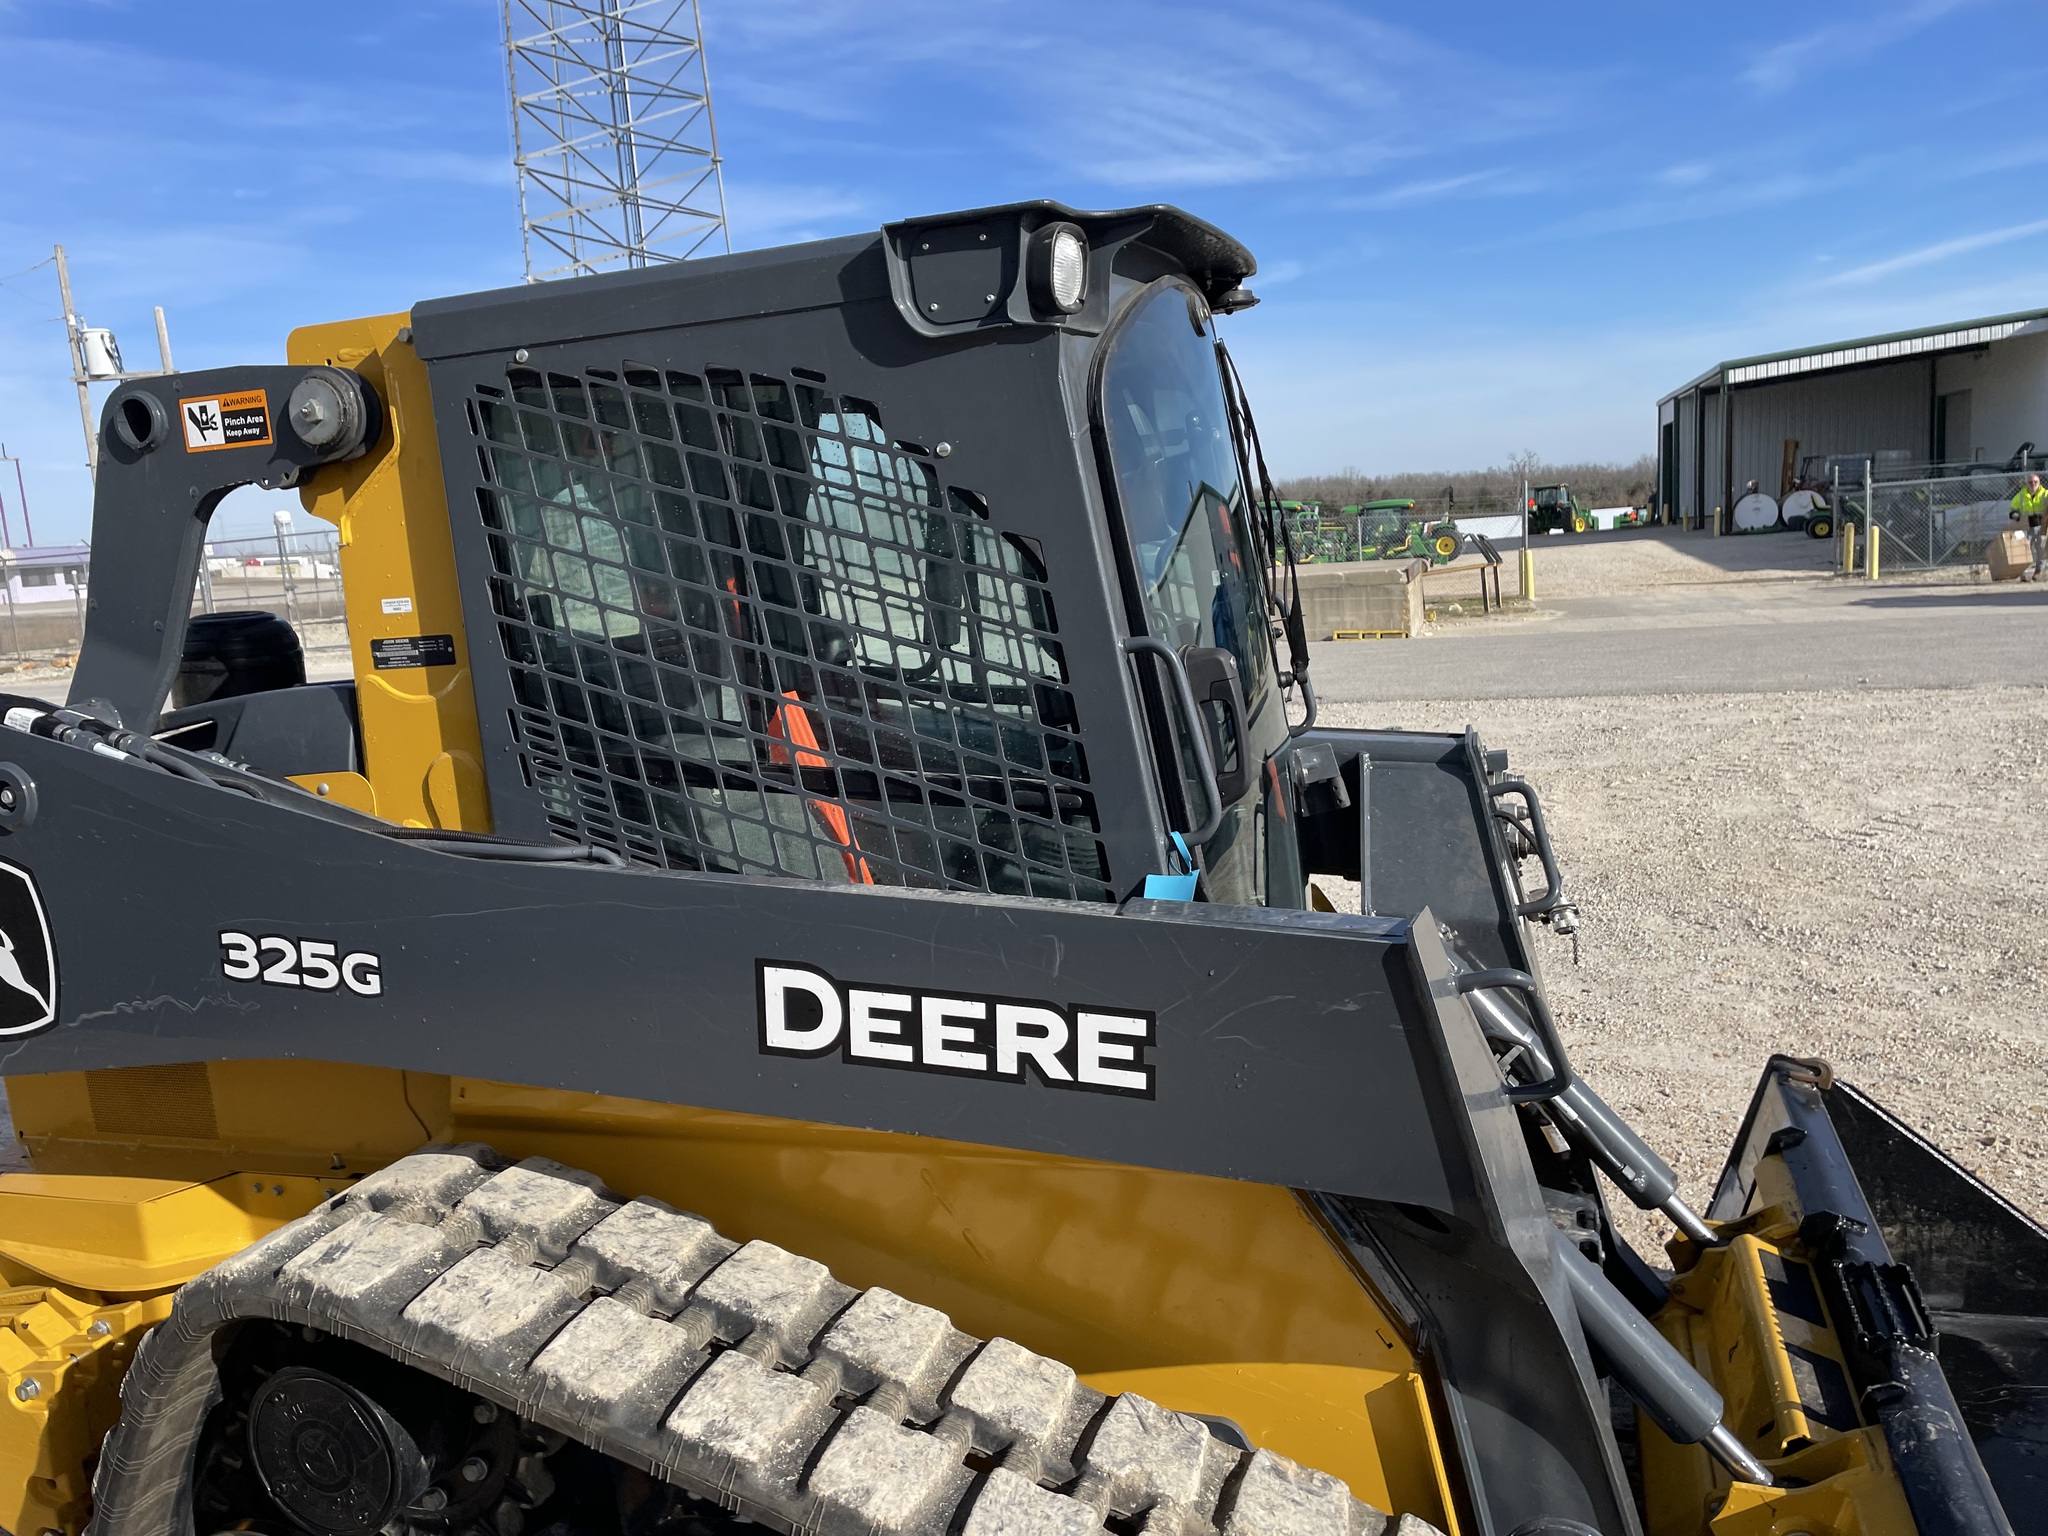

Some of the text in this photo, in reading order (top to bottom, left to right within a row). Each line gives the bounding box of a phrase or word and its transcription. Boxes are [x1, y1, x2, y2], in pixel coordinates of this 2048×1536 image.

[230, 395, 262, 406] WARNING
[224, 414, 264, 427] Pinch Area
[226, 426, 260, 438] Keep Away
[220, 932, 381, 995] 325G
[763, 966, 1147, 1090] DEERE
